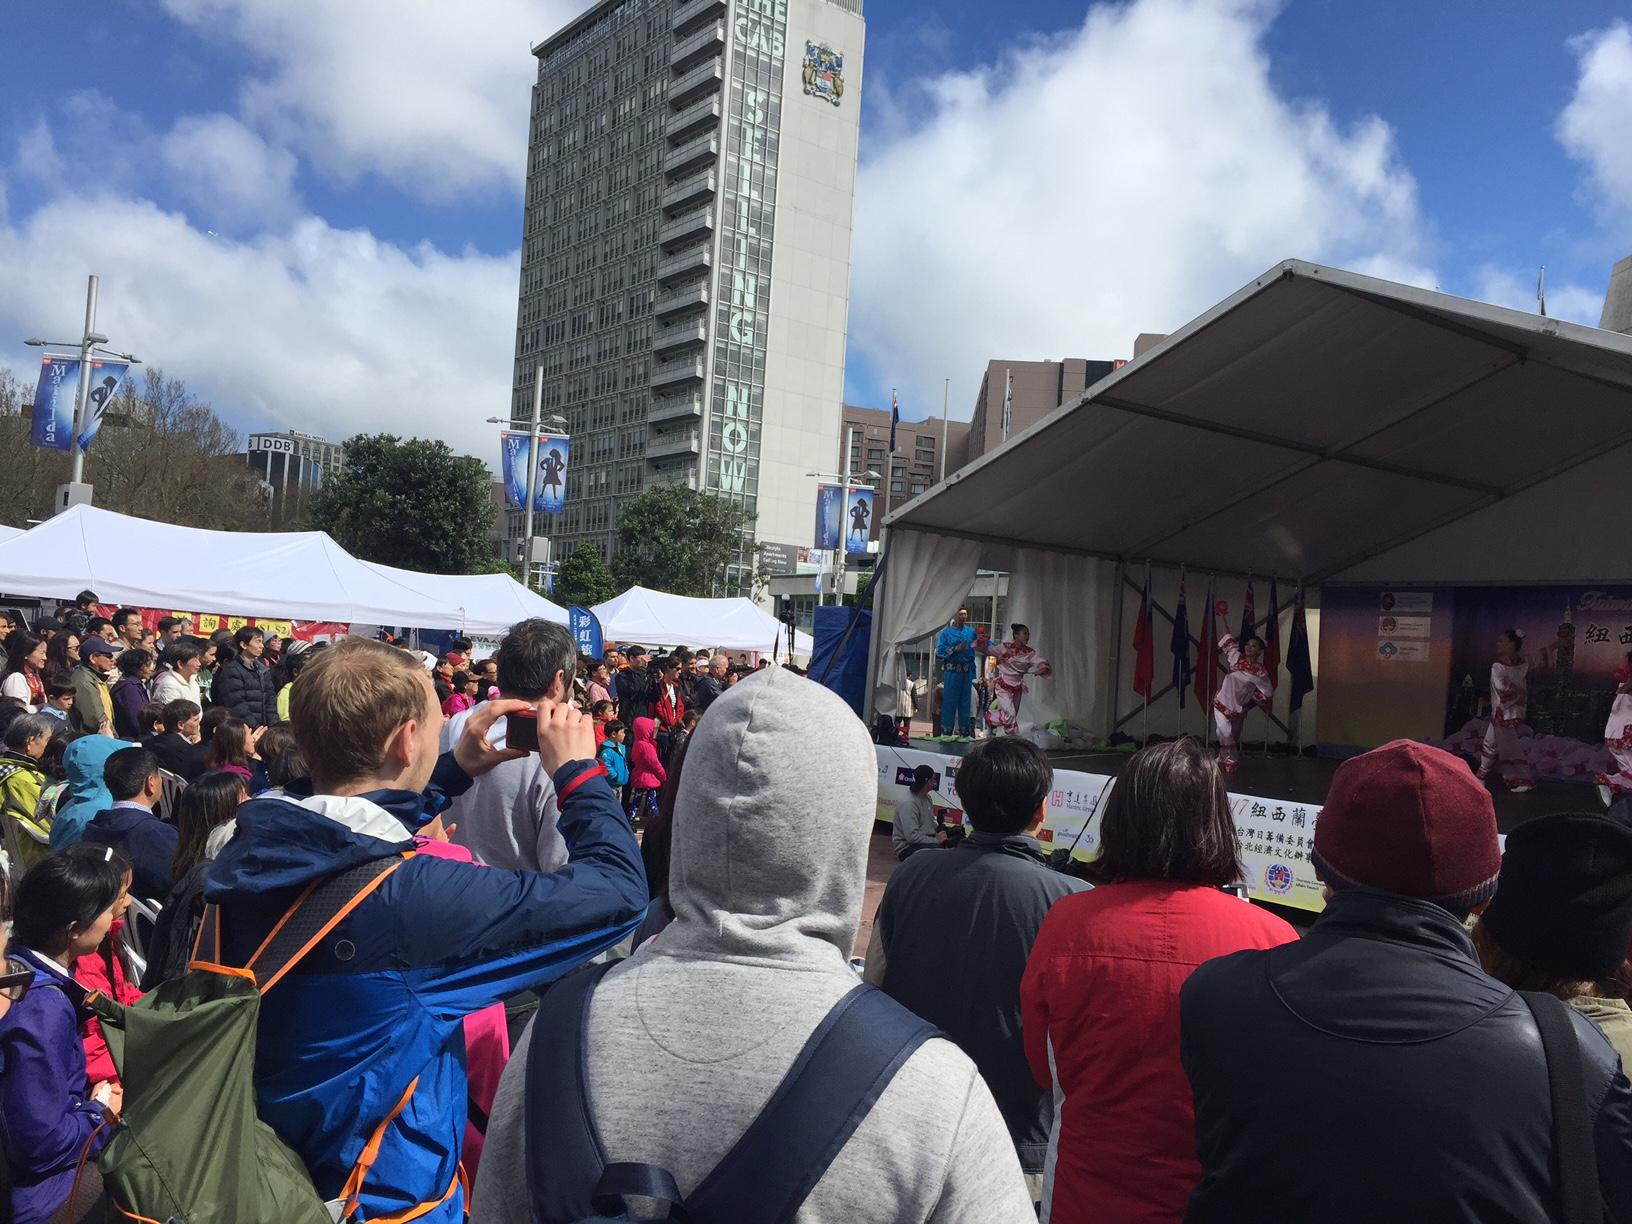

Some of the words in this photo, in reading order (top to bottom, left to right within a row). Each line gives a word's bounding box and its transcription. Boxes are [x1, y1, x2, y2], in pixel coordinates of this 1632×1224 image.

[735, 17, 784, 56] CAB
[731, 91, 764, 344] SELLING
[263, 439, 291, 451] DDB
[720, 385, 749, 492] NOW
